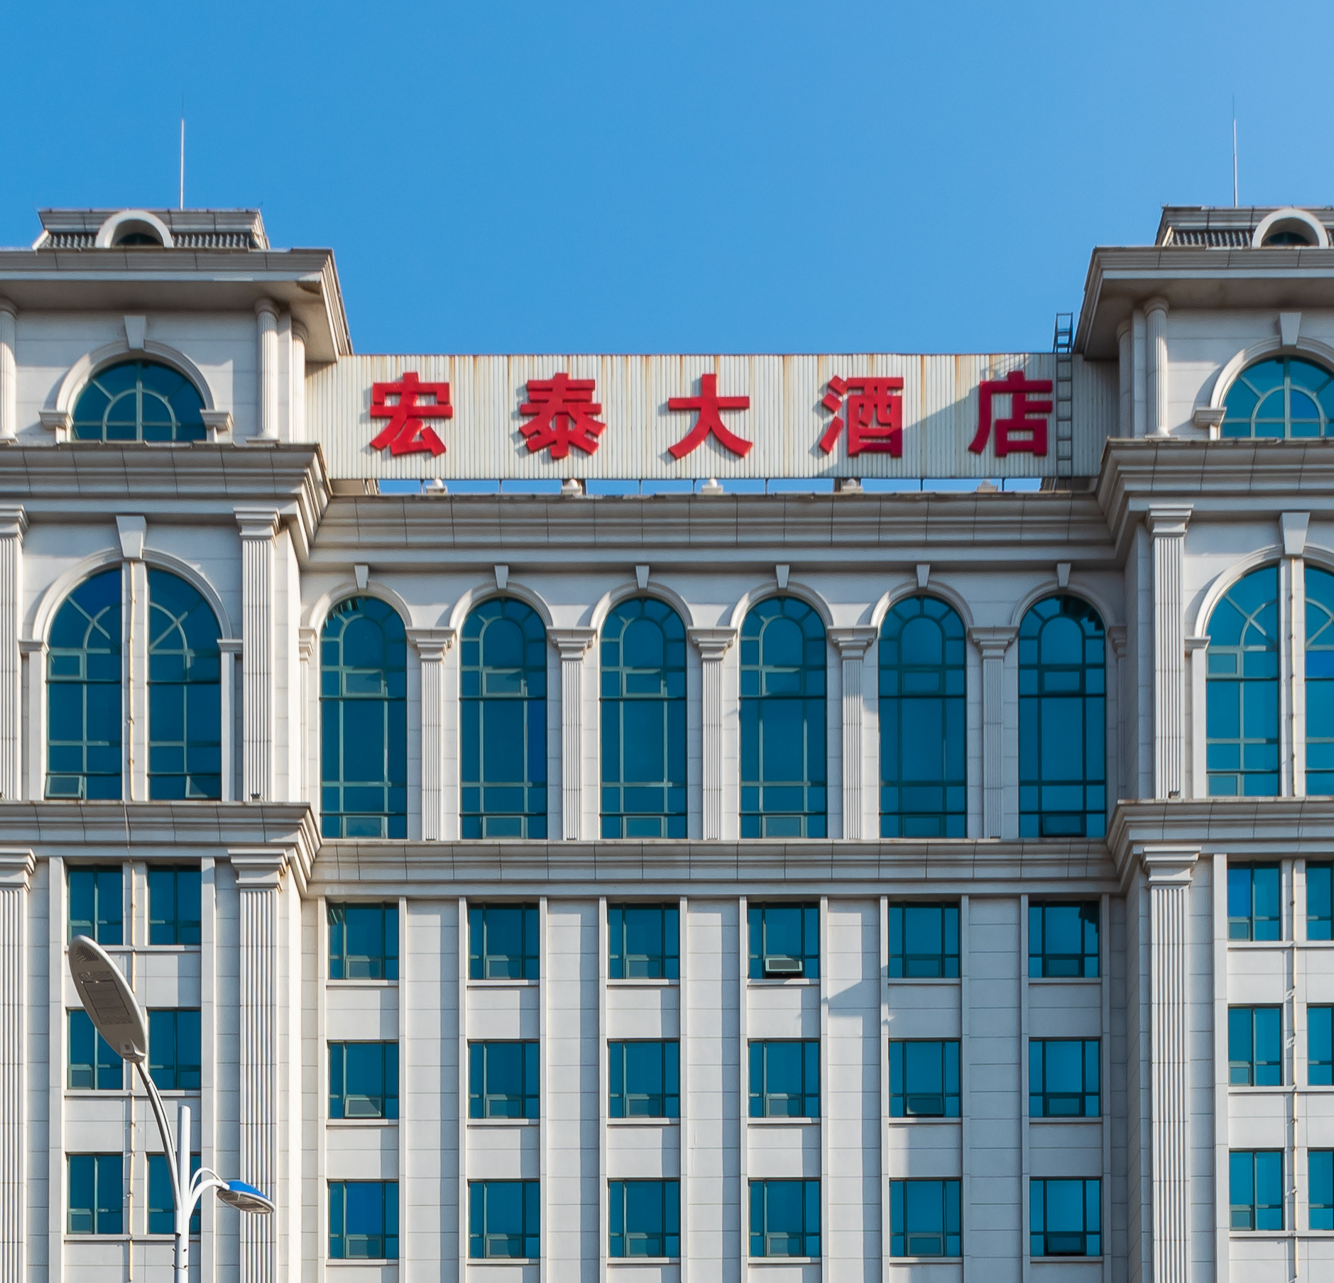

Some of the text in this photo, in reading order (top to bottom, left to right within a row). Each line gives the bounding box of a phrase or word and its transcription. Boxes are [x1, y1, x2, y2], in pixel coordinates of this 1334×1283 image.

[369, 371, 1053, 460] 宏泰大酒店
